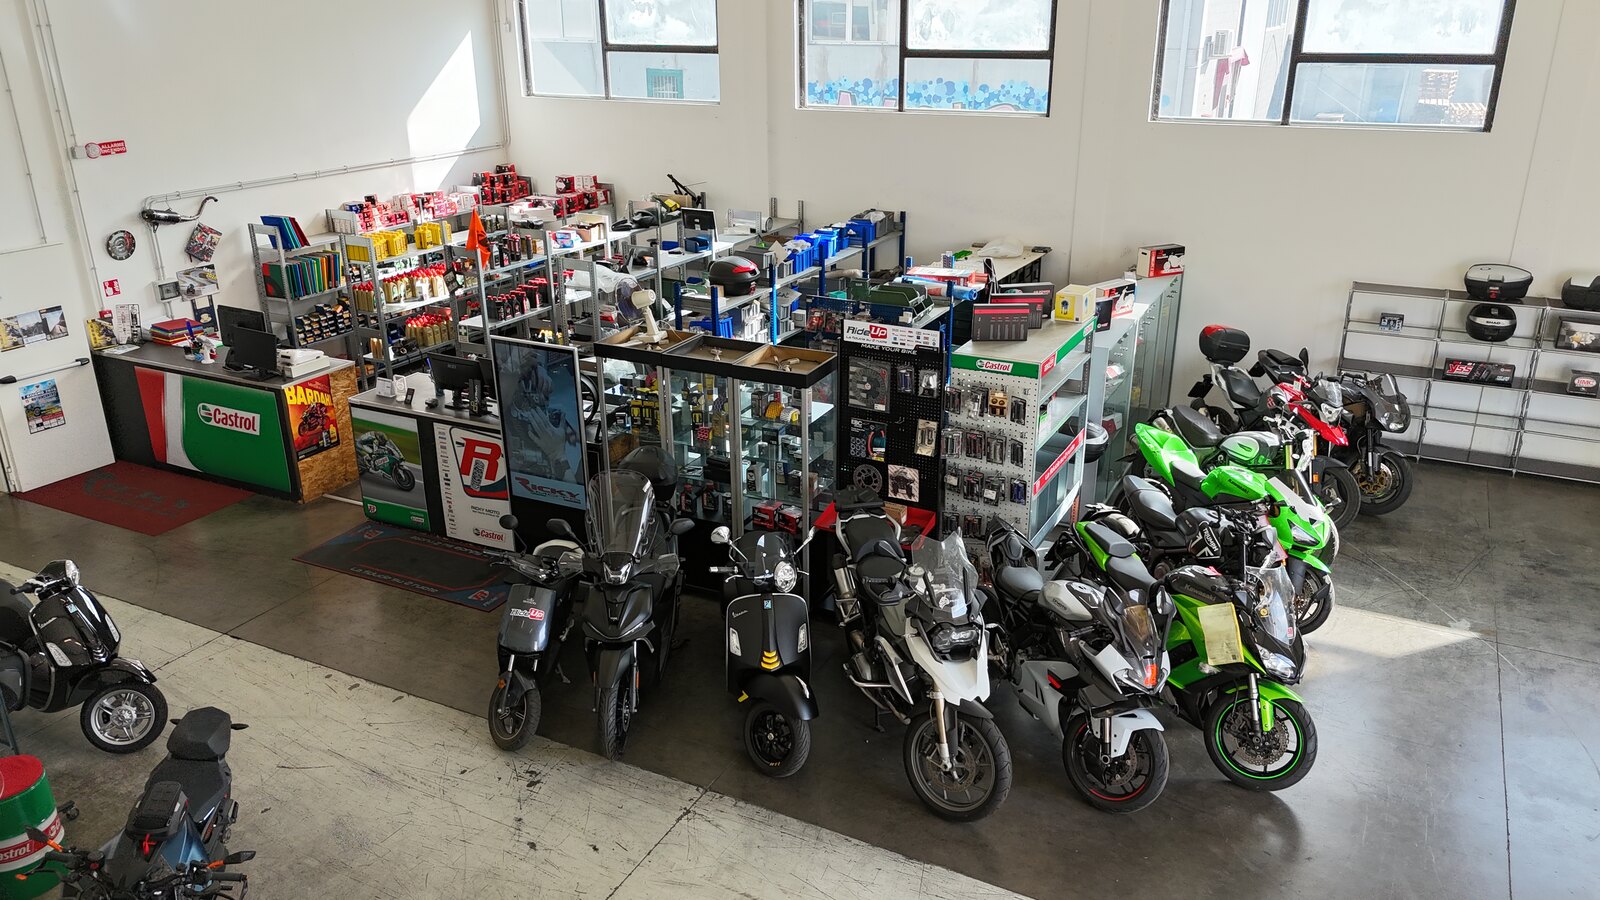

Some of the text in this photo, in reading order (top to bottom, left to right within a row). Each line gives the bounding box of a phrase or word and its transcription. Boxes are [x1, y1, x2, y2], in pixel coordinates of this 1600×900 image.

[861, 343, 880, 351] MAKE
[984, 361, 1011, 371] Castrol
[213, 407, 257, 432] Castrol
[480, 529, 504, 541] Castrol
[1203, 527, 1219, 552] TRIUMPH
